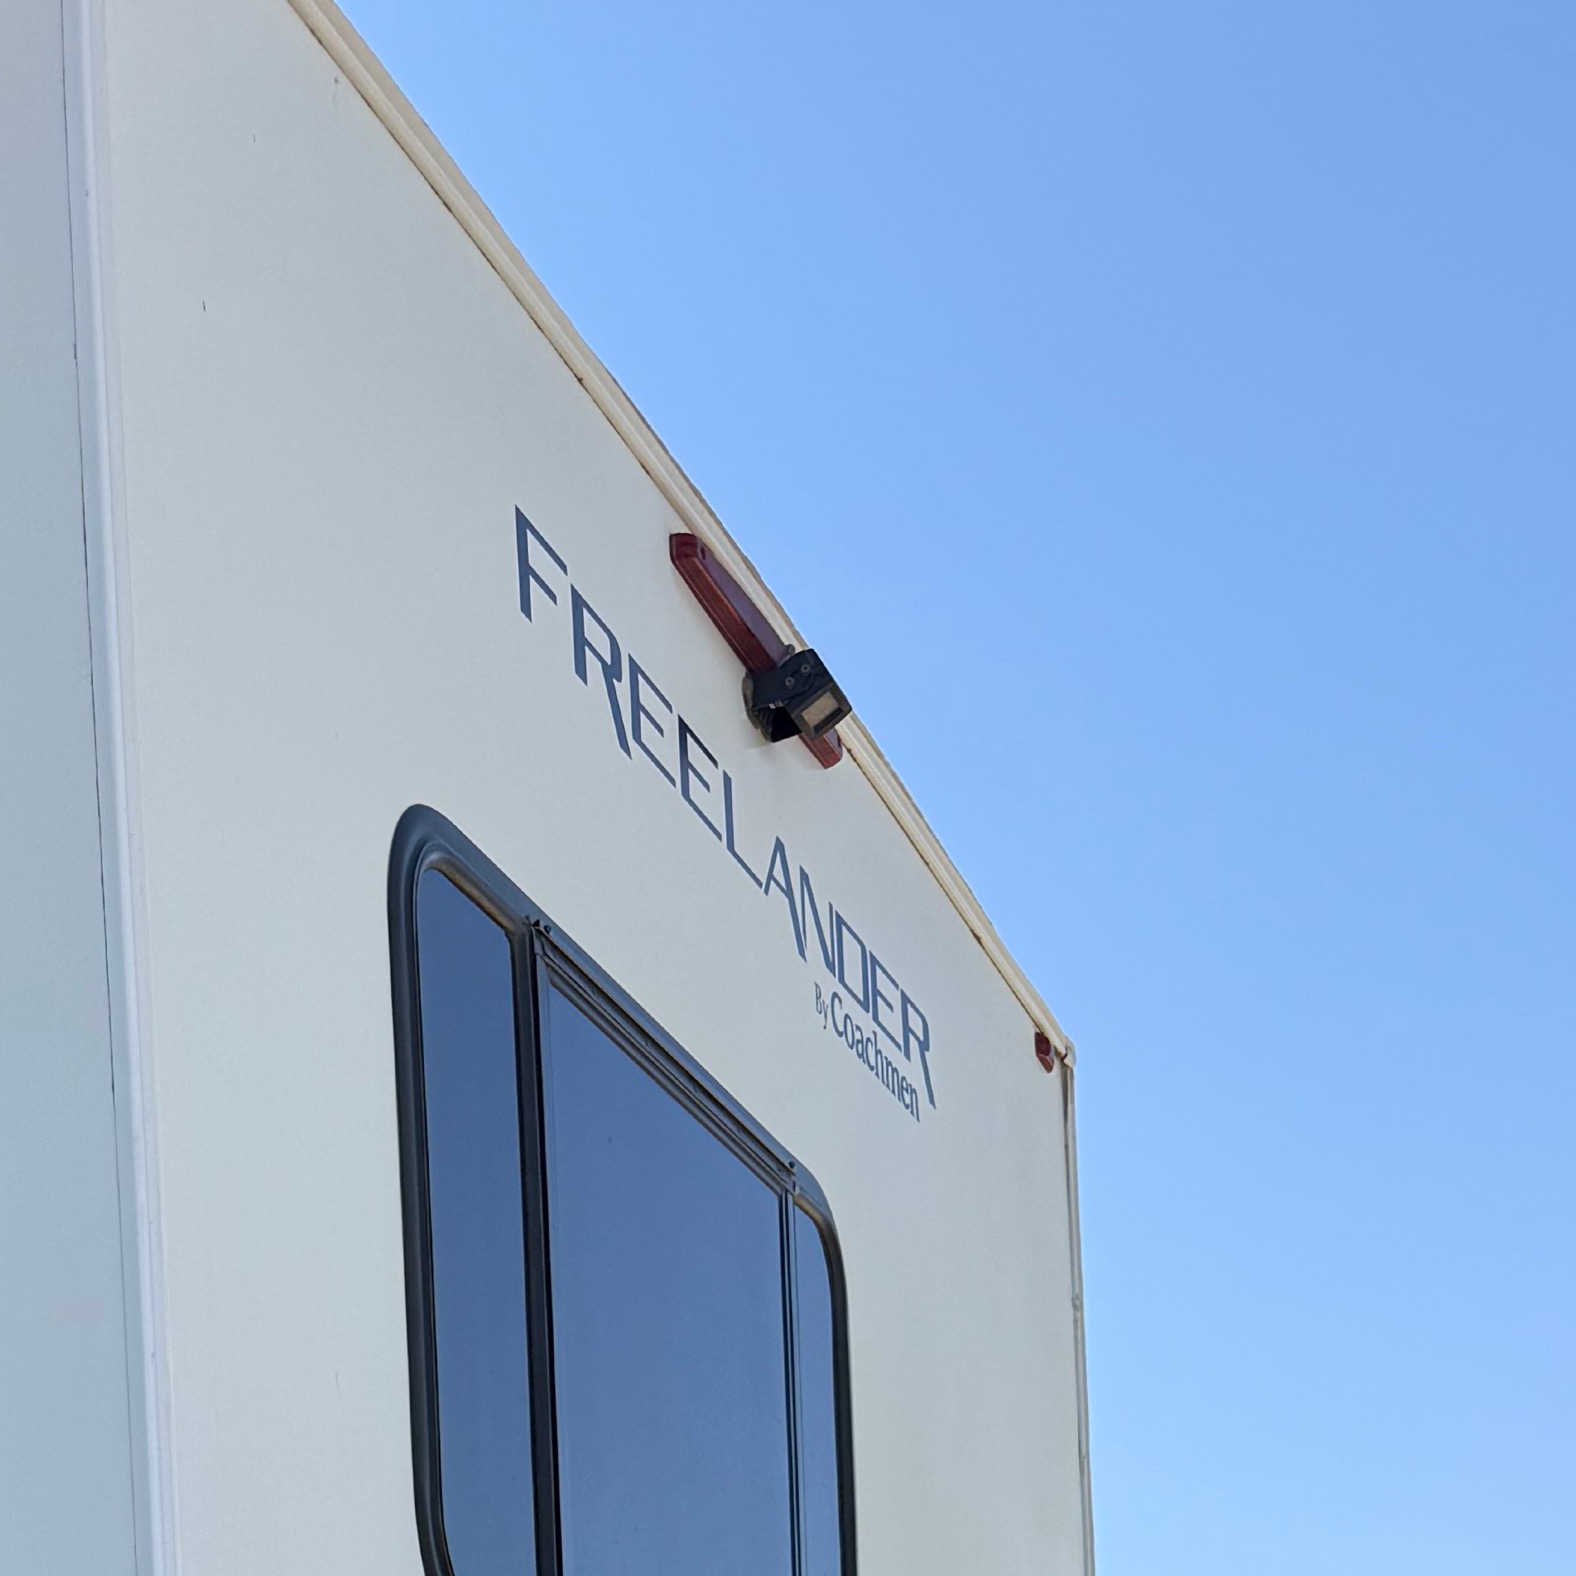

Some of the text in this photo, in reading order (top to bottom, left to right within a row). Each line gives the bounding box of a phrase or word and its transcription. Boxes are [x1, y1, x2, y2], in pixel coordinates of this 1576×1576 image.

[514, 505, 937, 1110] FREELANDER
[814, 981, 921, 1123] By Coachmen
